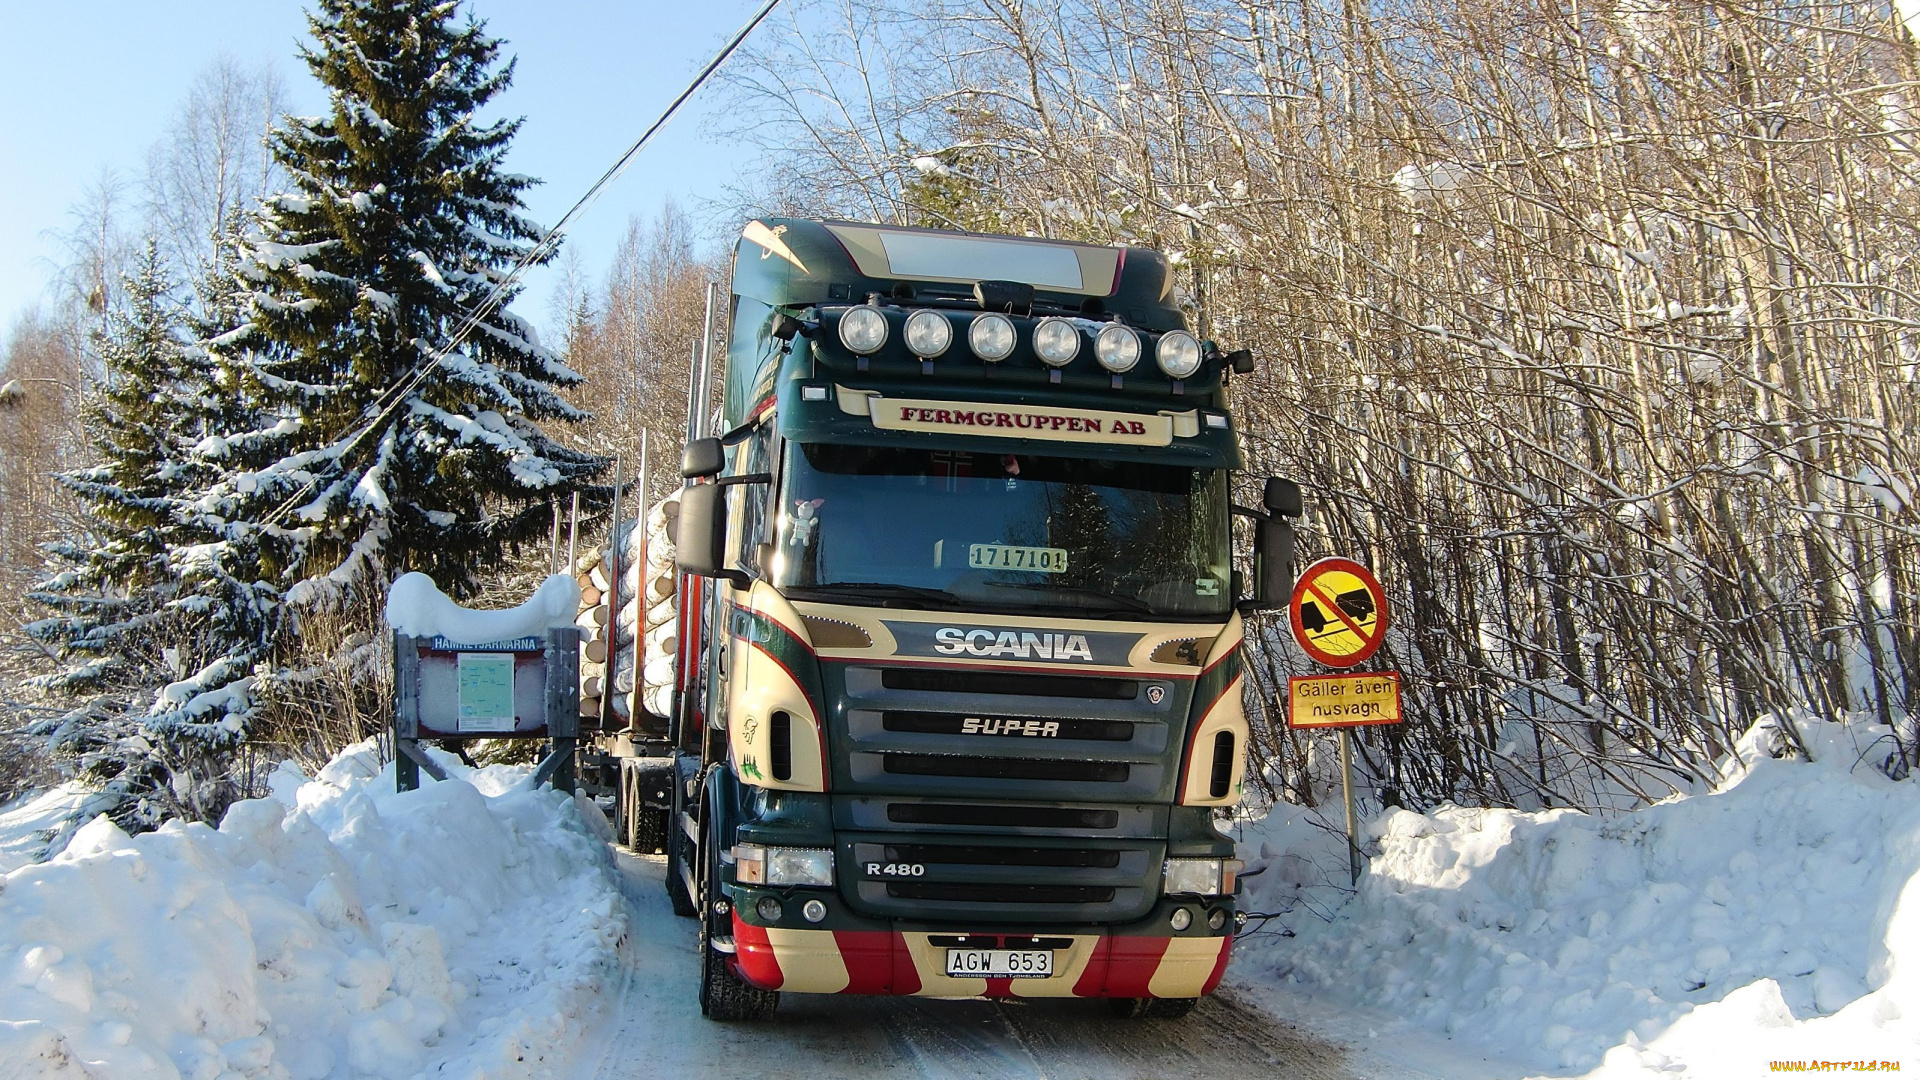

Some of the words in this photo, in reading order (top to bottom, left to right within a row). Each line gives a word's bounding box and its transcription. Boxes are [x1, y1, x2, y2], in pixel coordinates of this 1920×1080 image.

[900, 406, 1102, 433] FERMGRUPPEN
[1110, 420, 1146, 435] AB
[974, 547, 1062, 569] 1717101
[934, 627, 1093, 661] SCANIA
[1298, 682, 1347, 698] Gäller
[1355, 680, 1392, 694] även
[1312, 700, 1380, 717] husvagn
[961, 717, 1060, 738] SUPER
[952, 952, 991, 971] AGW
[1008, 953, 1048, 971] 653
